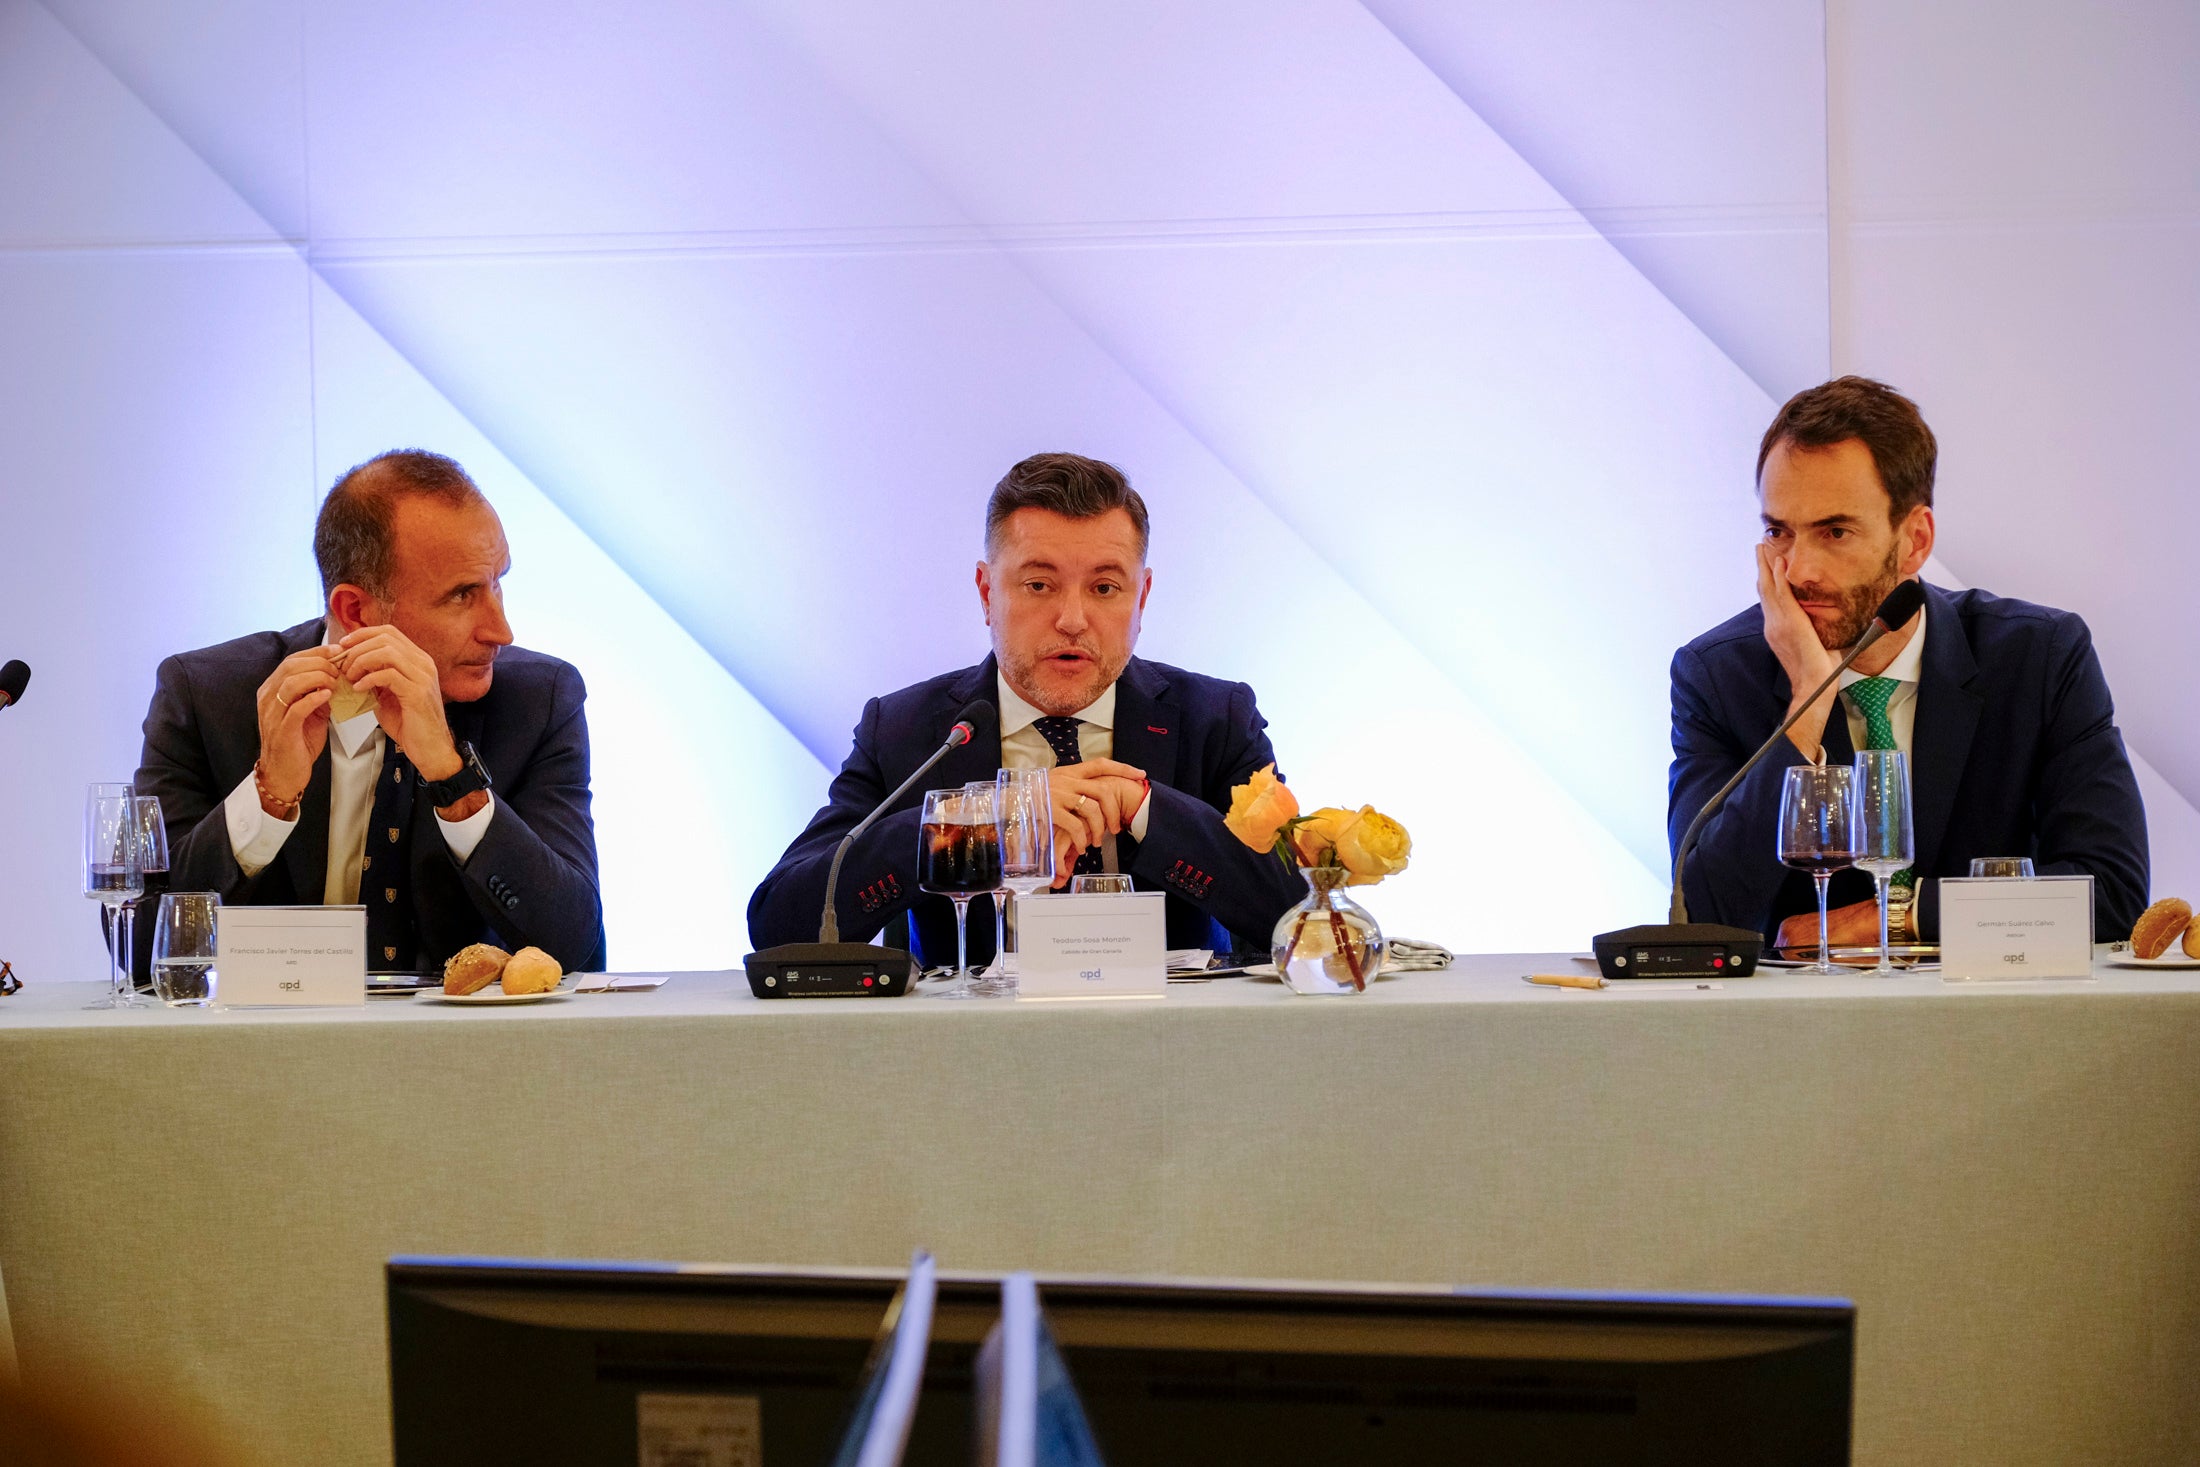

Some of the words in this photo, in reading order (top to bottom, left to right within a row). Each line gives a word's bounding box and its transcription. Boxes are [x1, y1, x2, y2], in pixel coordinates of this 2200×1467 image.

[2034, 919, 2056, 927] Calvo
[229, 947, 265, 955] Francisco
[266, 947, 287, 955] Javier
[289, 947, 312, 955] Torres
[313, 947, 325, 955] del
[326, 947, 354, 955] Castillo
[2003, 952, 2025, 965] apd
[1080, 968, 1101, 981] apd
[279, 979, 300, 992] apd
